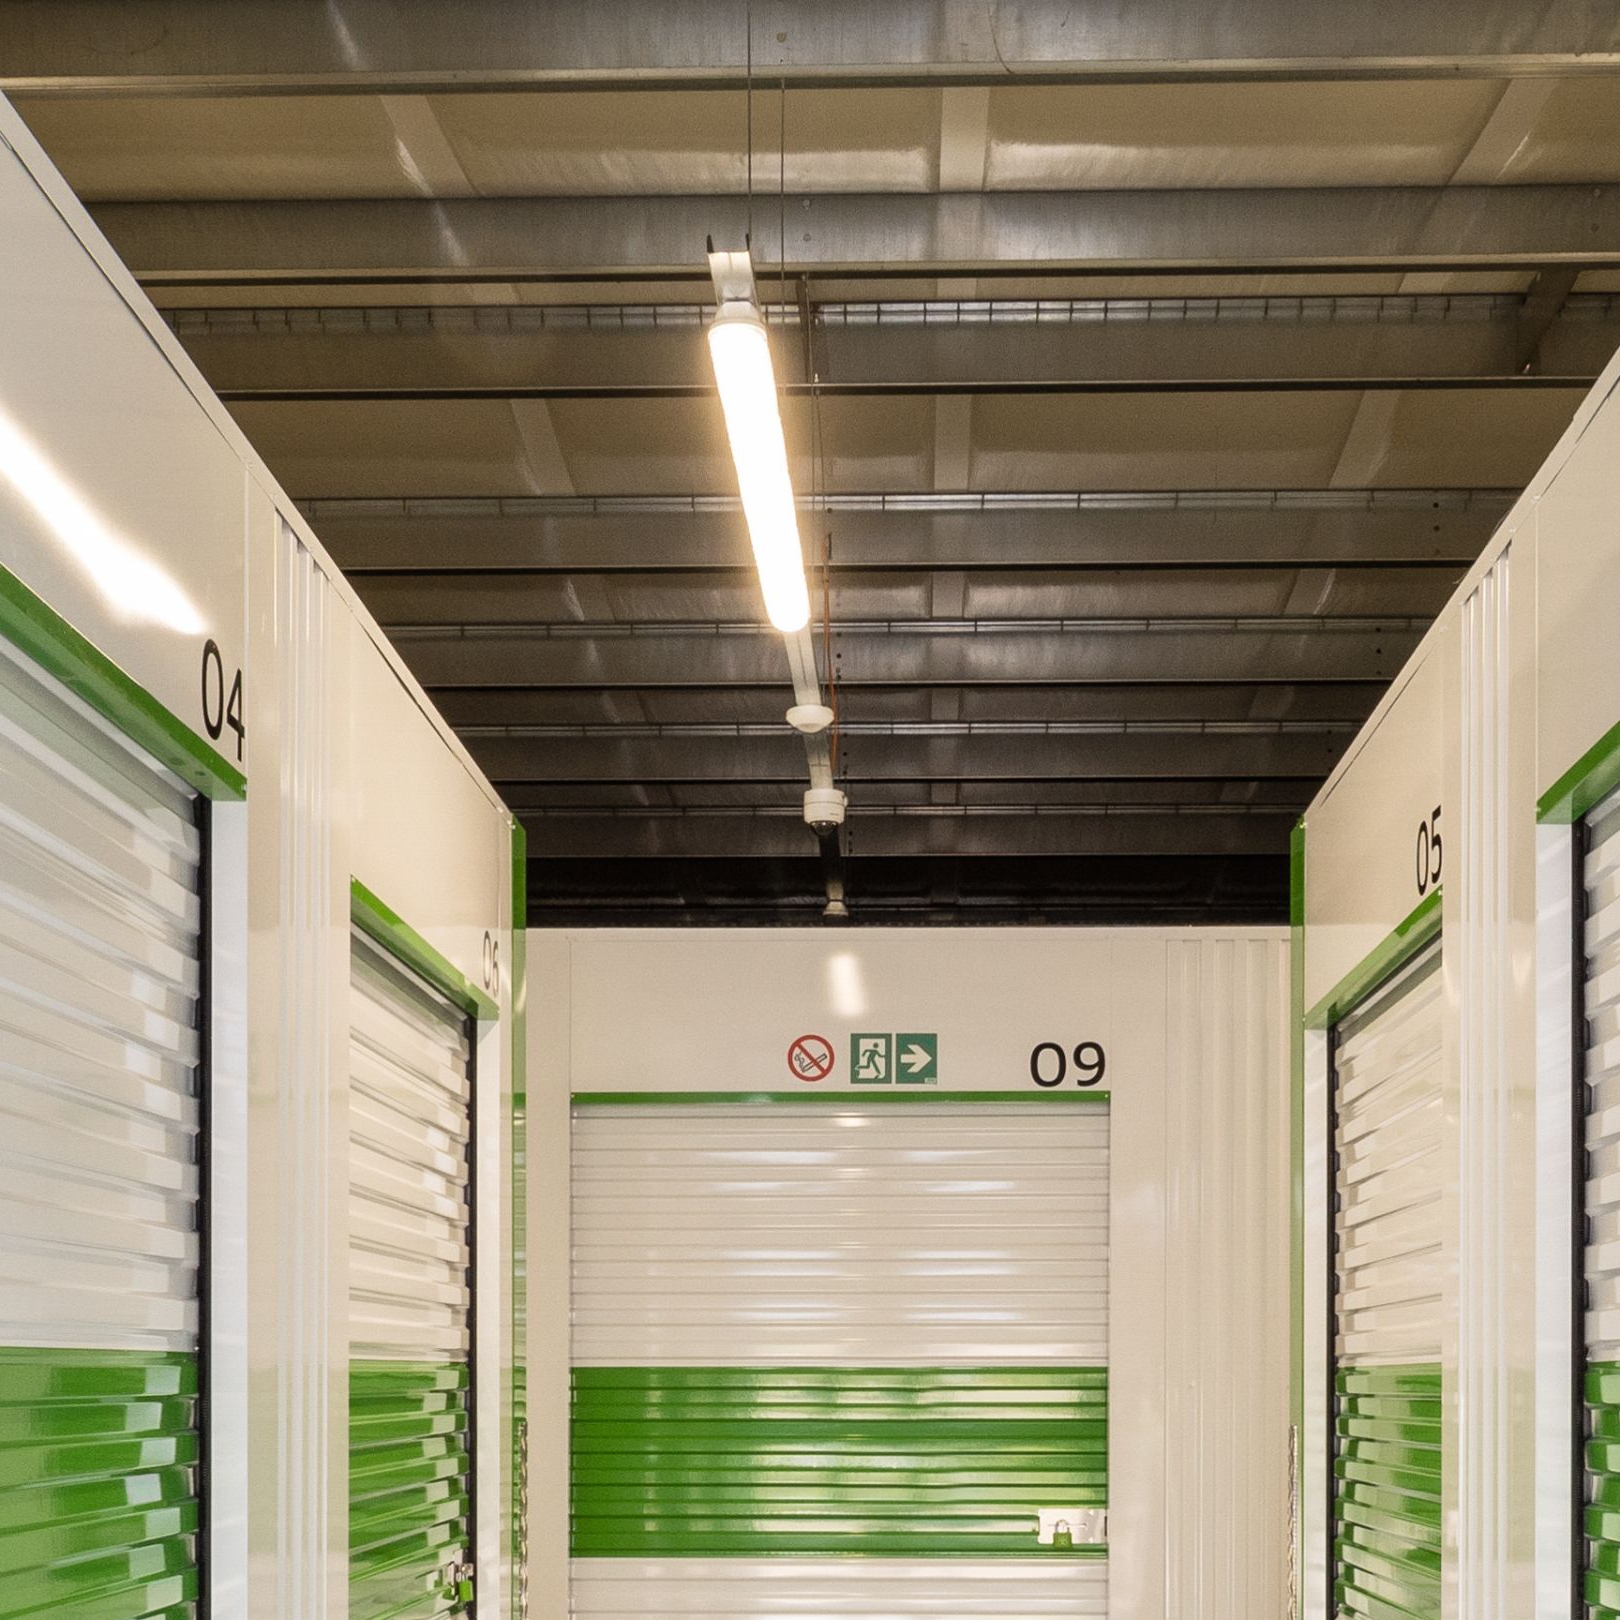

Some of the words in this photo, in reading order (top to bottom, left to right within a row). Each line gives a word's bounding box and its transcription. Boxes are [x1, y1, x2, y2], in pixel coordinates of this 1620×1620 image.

[201, 638, 245, 762] 04
[1416, 804, 1443, 896] 05
[482, 930, 499, 998] 06
[1030, 1041, 1106, 1088] 09
